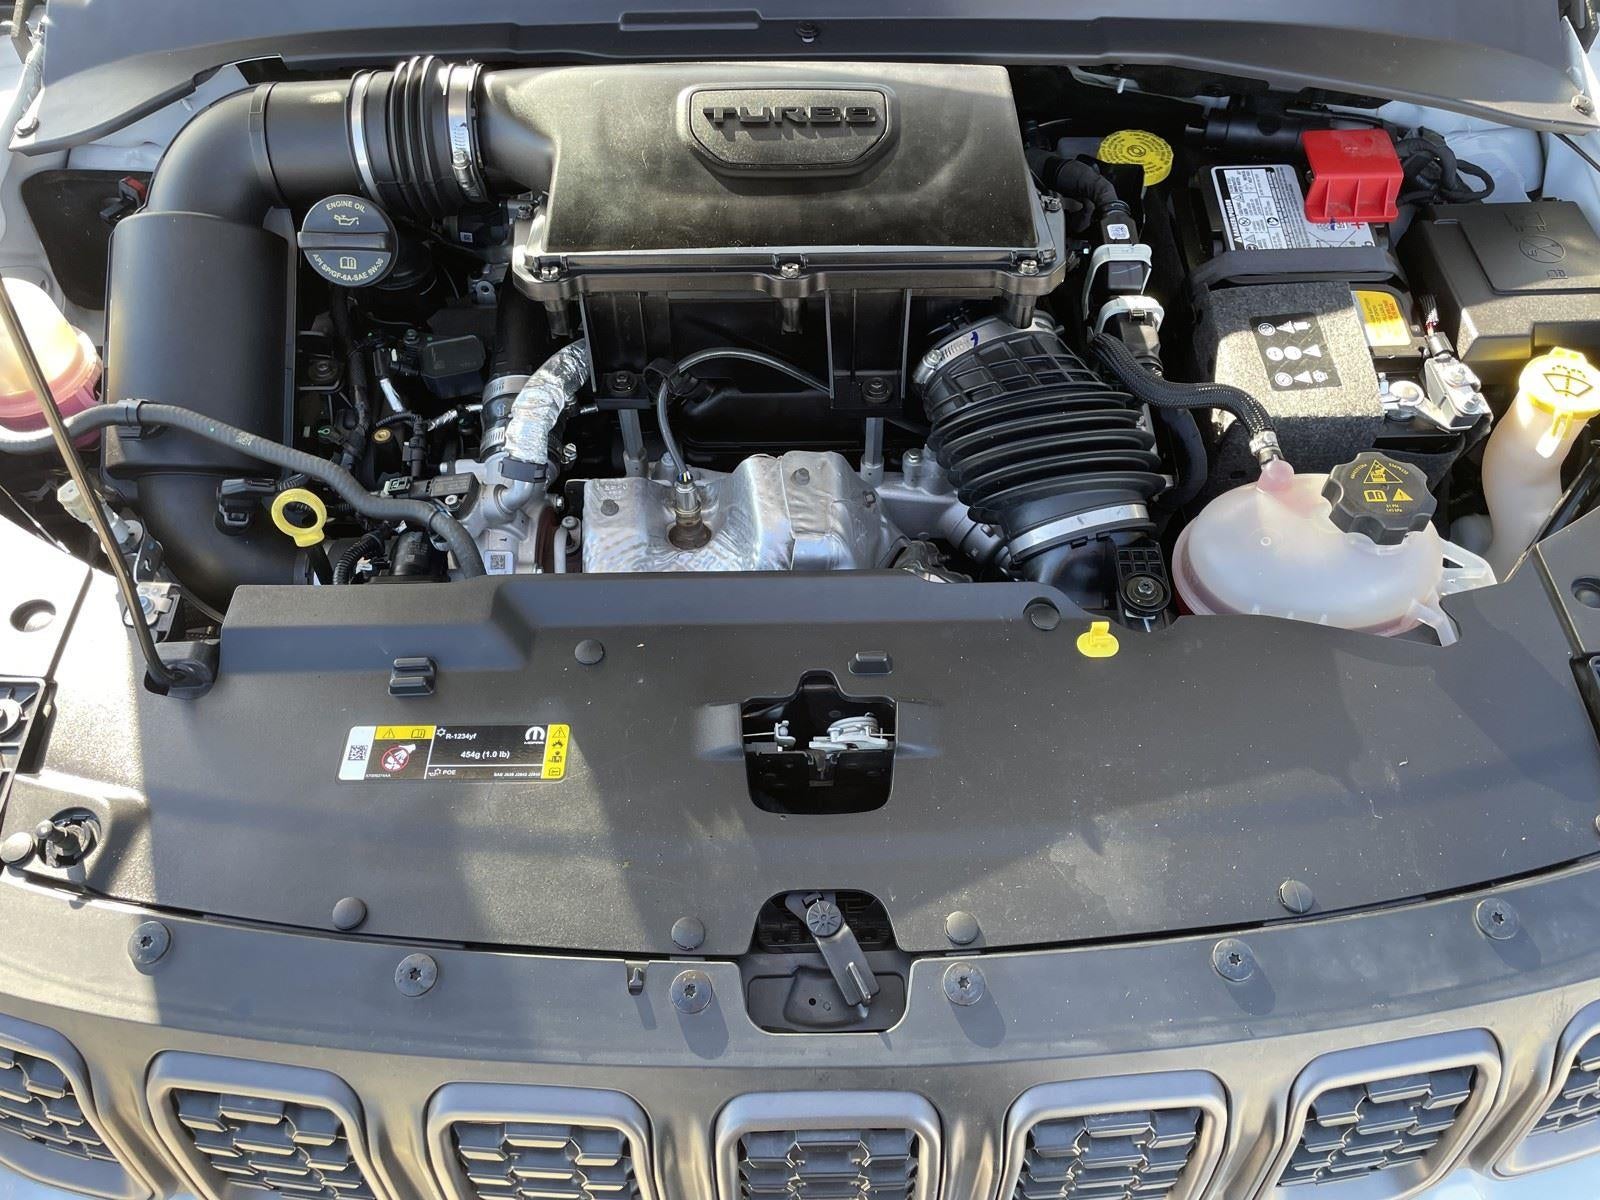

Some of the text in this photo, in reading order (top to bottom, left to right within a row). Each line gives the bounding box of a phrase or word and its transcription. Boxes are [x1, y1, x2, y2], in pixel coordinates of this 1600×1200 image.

[703, 106, 878, 124] TURBO
[326, 201, 366, 213] ENGINE OIL
[312, 254, 324, 266] API
[445, 732, 477, 740] R-1234yf
[460, 751, 510, 759] 454g (1.0 lb)
